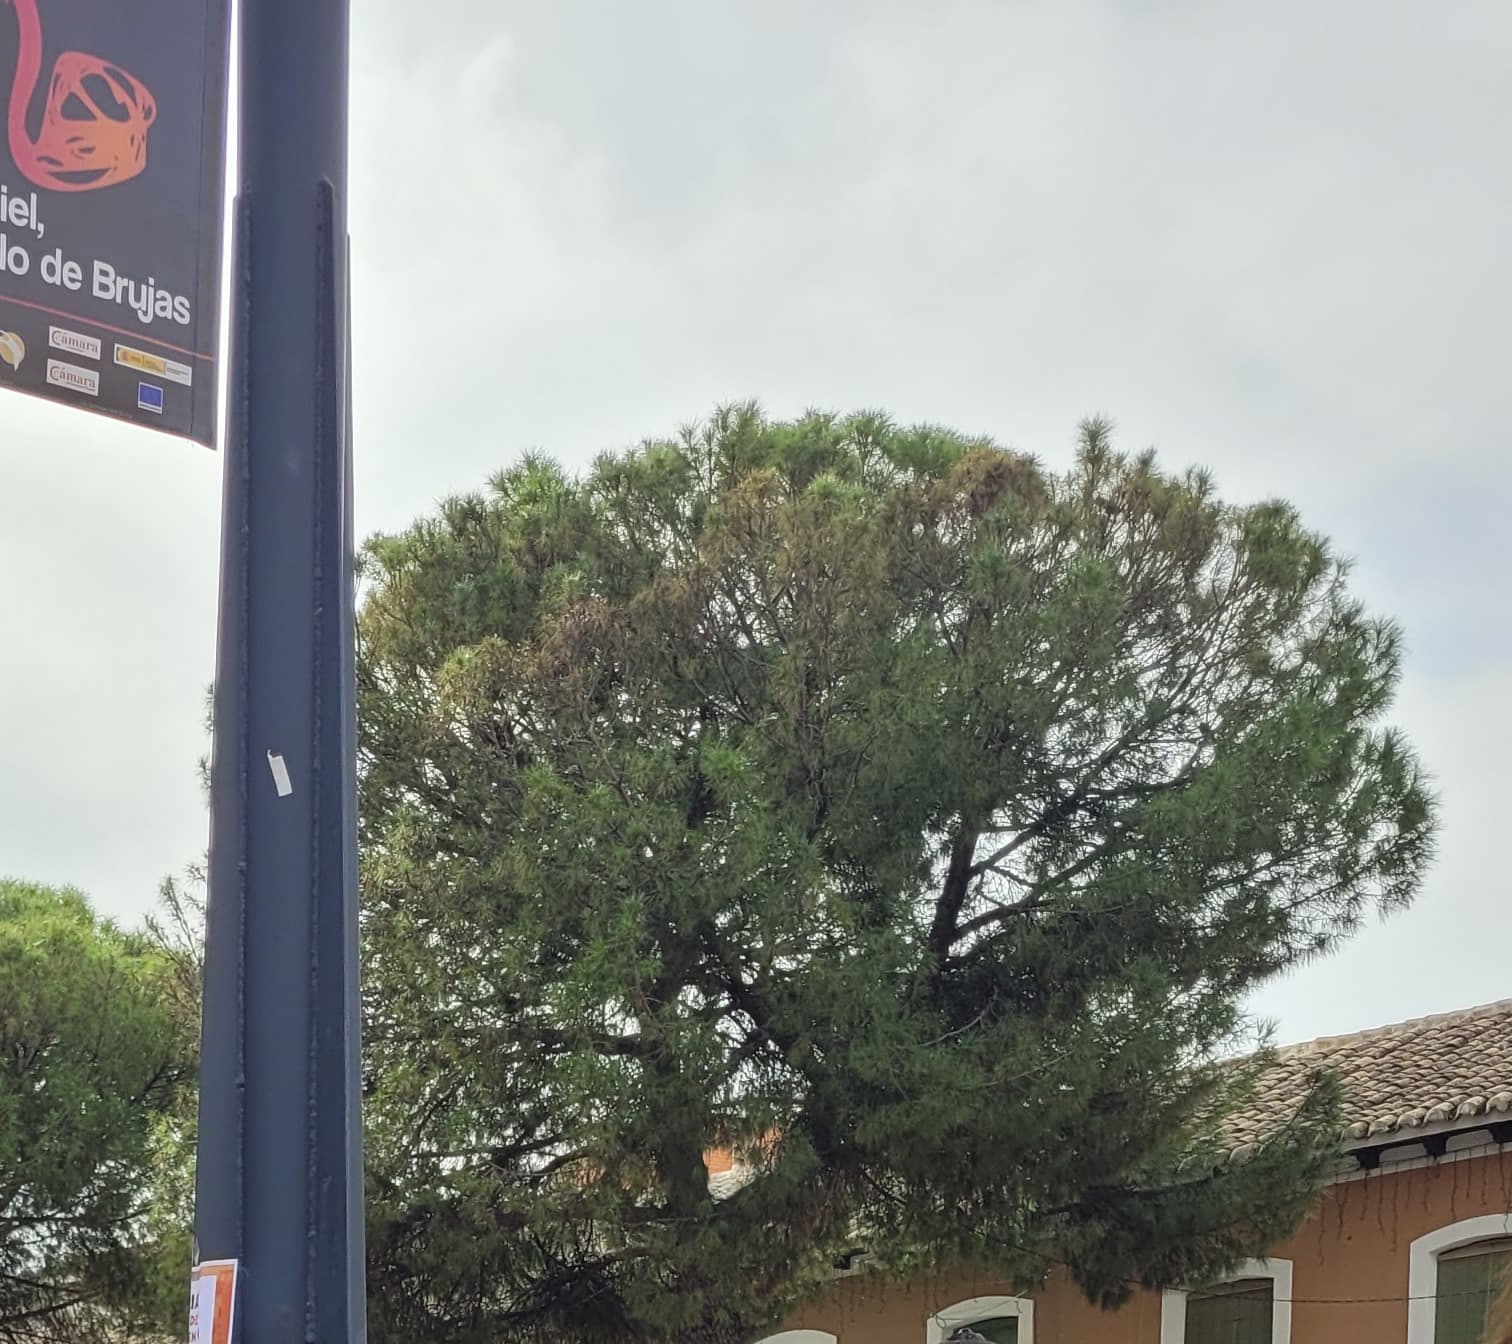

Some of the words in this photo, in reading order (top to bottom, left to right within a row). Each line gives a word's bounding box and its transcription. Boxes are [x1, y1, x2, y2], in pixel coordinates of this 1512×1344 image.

[40, 248, 83, 290] de
[92, 259, 191, 325] Brujas
[51, 330, 98, 353] Cámara
[49, 366, 96, 389] Cámara
